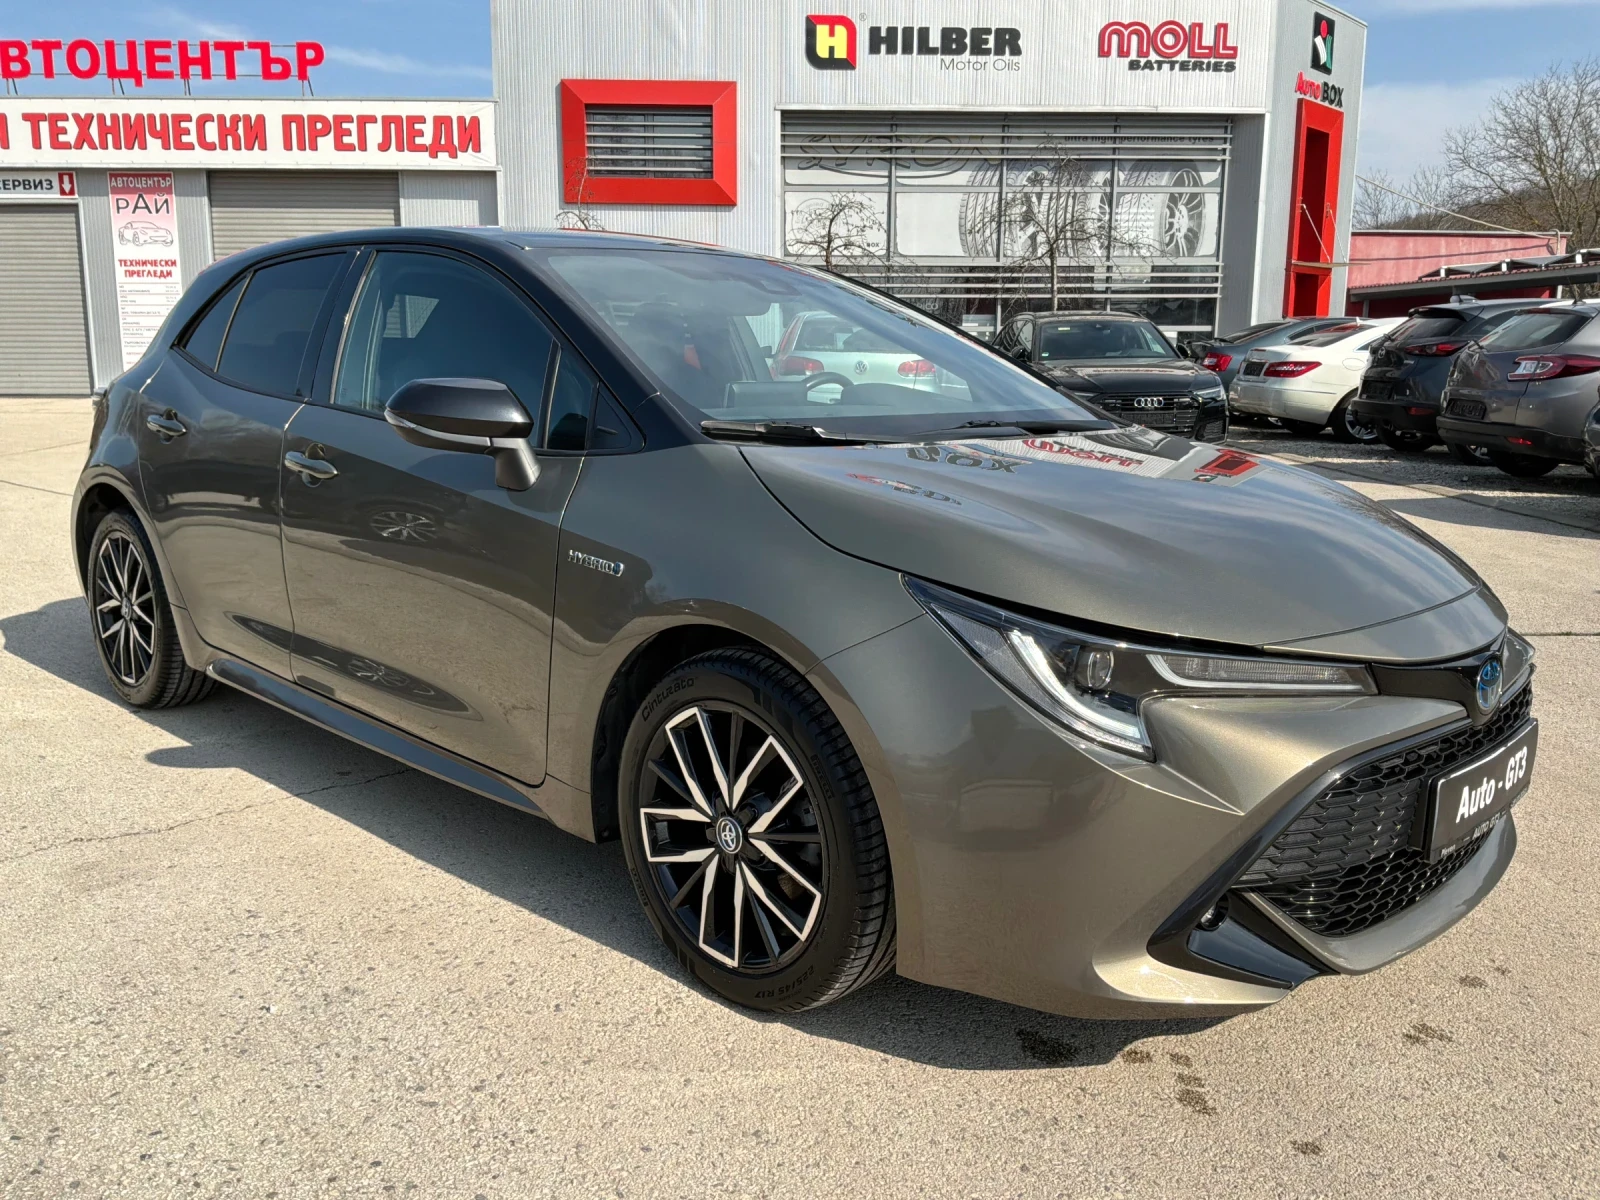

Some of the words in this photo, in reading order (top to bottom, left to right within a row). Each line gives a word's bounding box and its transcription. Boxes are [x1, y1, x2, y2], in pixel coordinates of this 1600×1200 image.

[868, 26, 1022, 56] HILBER
[1098, 19, 1239, 59] MOLL
[940, 58, 987, 71] Motor
[993, 58, 1020, 71] Oils
[1128, 59, 1237, 72] BATTERIES
[21, 113, 267, 151] ТЕХНИЧЕСКИ
[282, 114, 481, 158] ПРЕГЛЕДИ
[0, 178, 54, 191] ЕРВИЗ
[110, 176, 172, 189] АВТОЦЕНТЪР
[118, 259, 177, 268] ТЕХНИЧЕСКИ
[124, 269, 173, 279] ПРЕГЛЕДИ
[1456, 776, 1496, 823] Auto
[1505, 746, 1528, 790] GT3
